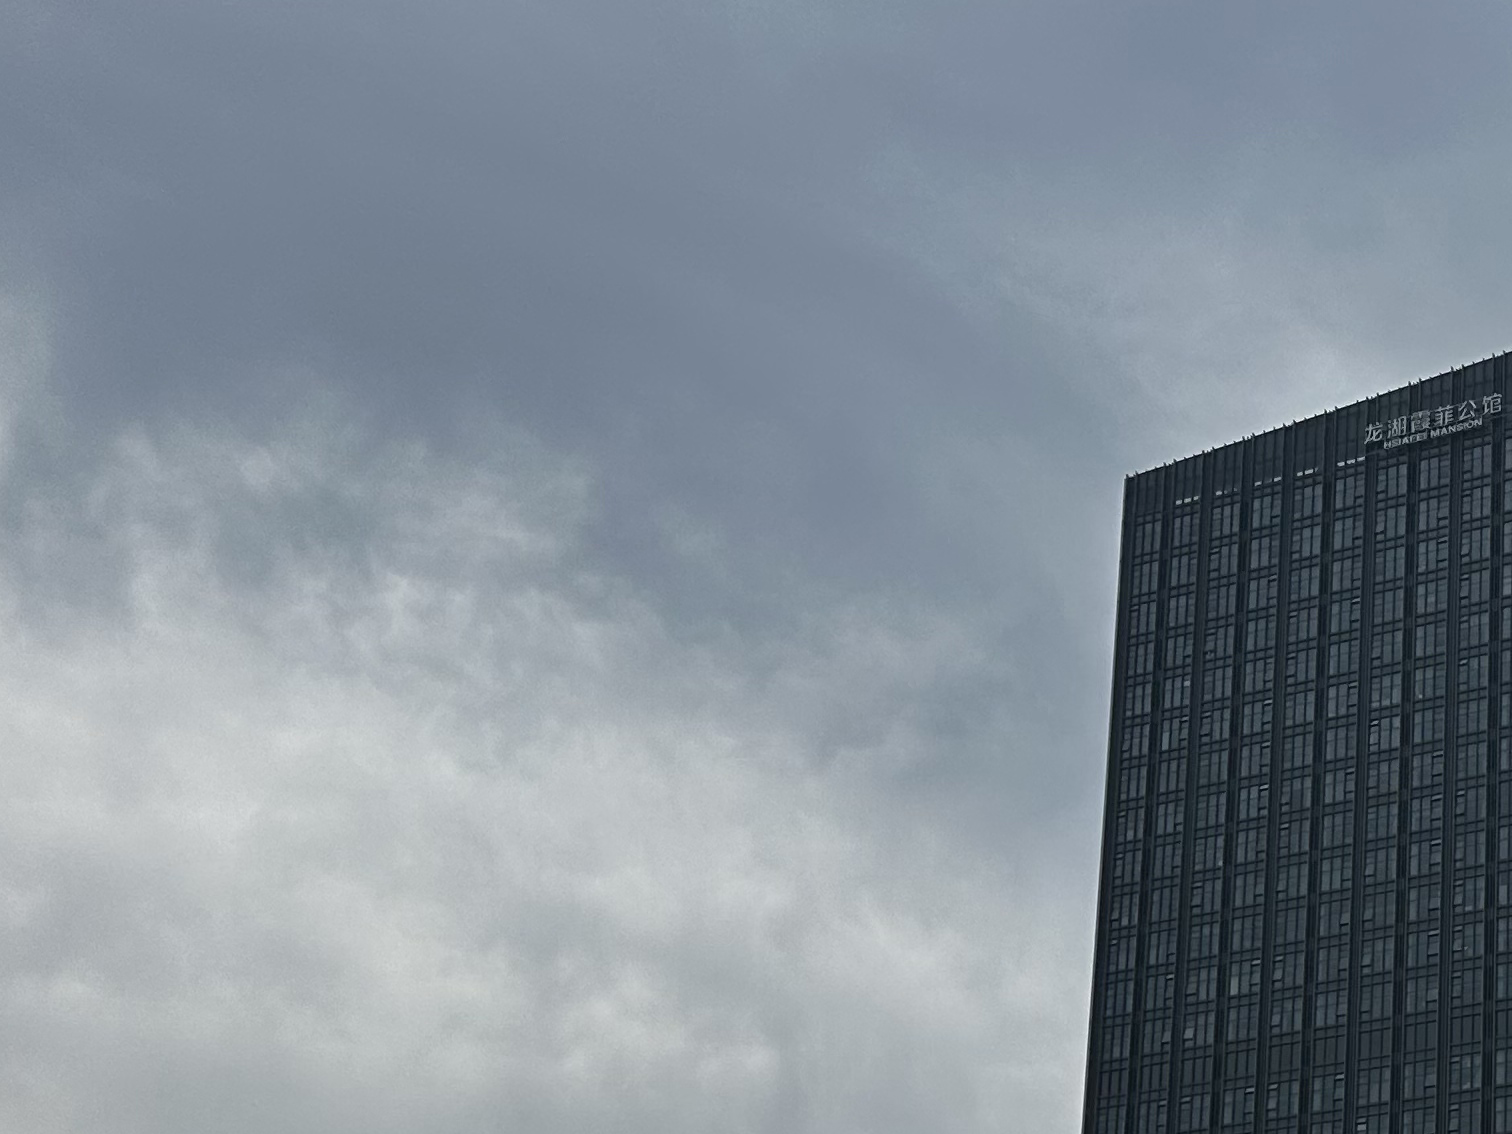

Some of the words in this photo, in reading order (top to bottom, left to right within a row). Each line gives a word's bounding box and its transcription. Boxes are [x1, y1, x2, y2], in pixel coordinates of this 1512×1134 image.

[1364, 393, 1502, 444] 龙湖霞菲公馆
[1430, 418, 1483, 439] MANSION
